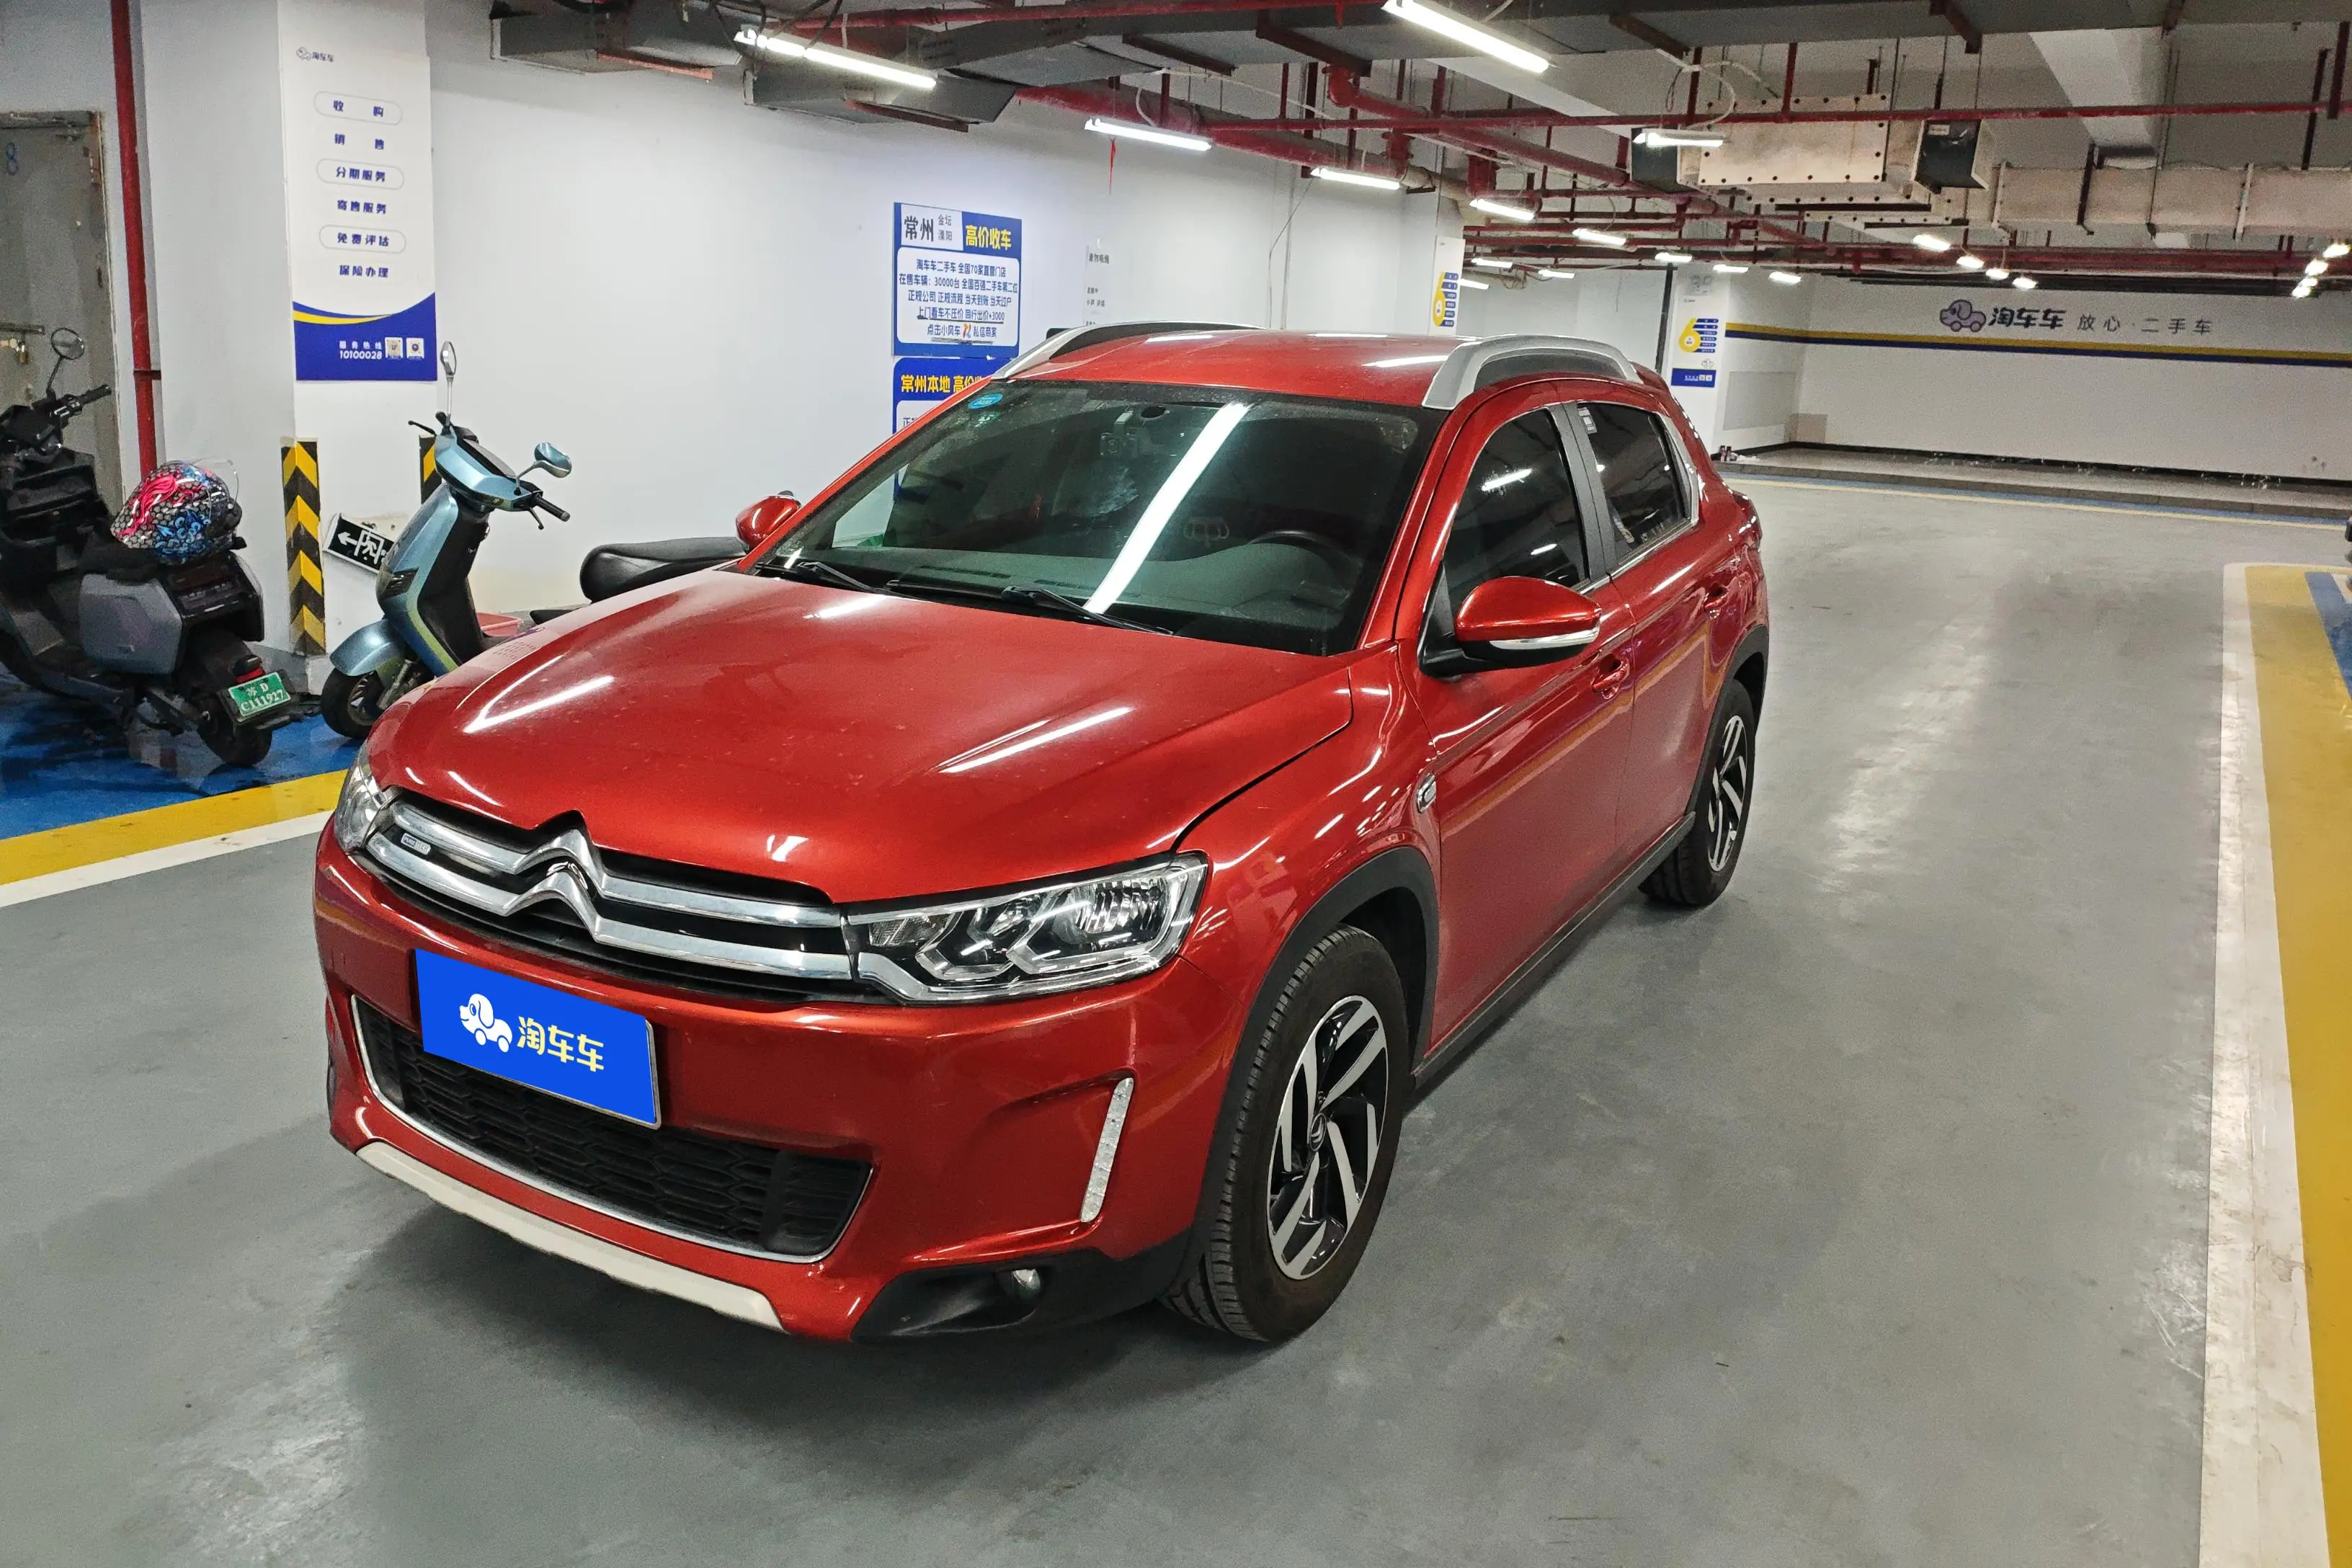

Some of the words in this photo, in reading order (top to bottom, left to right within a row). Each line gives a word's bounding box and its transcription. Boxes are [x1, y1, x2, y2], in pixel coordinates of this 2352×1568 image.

[336, 166, 386, 183] 分期服务
[937, 214, 952, 226] 金坛
[904, 215, 934, 242] 常州
[337, 232, 389, 246] 免费评估
[965, 225, 1012, 250] 高价收车
[339, 264, 389, 278] 保险办理
[916, 259, 956, 273] 淘车车二手车
[908, 290, 936, 303] 正规公司
[937, 292, 964, 305] 正规流程
[1987, 307, 2067, 330] 淘车车
[927, 324, 961, 337] 点击小风车
[339, 350, 383, 360] 10100028
[901, 374, 950, 393] 常州本地
